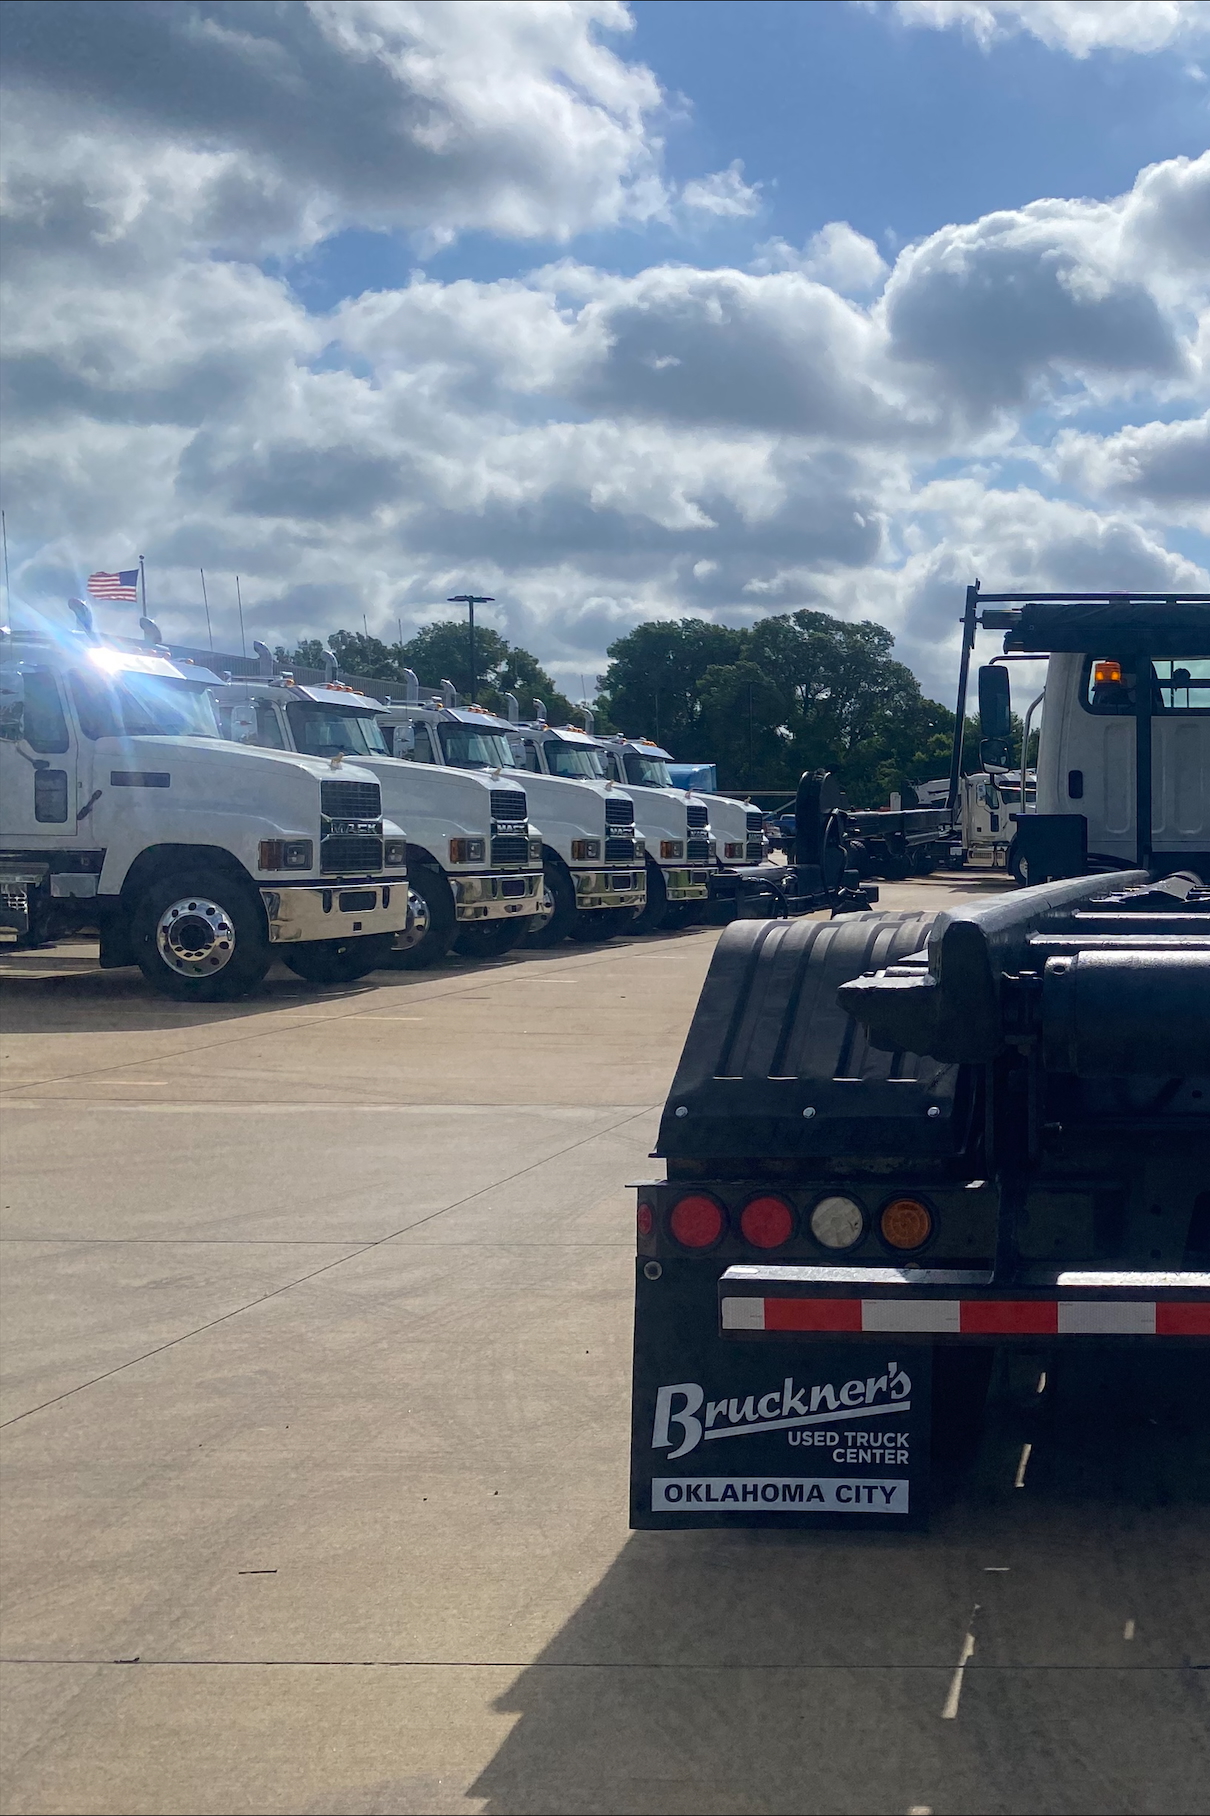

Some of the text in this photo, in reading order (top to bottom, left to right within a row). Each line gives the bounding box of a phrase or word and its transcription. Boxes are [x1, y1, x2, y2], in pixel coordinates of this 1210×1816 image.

[331, 822, 377, 834] MACK
[651, 1361, 912, 1460] Bruckner's
[788, 1431, 910, 1448] USED TRUCK
[832, 1448, 909, 1464] CENTER
[664, 1483, 897, 1504] OKLAHOMA CITY
